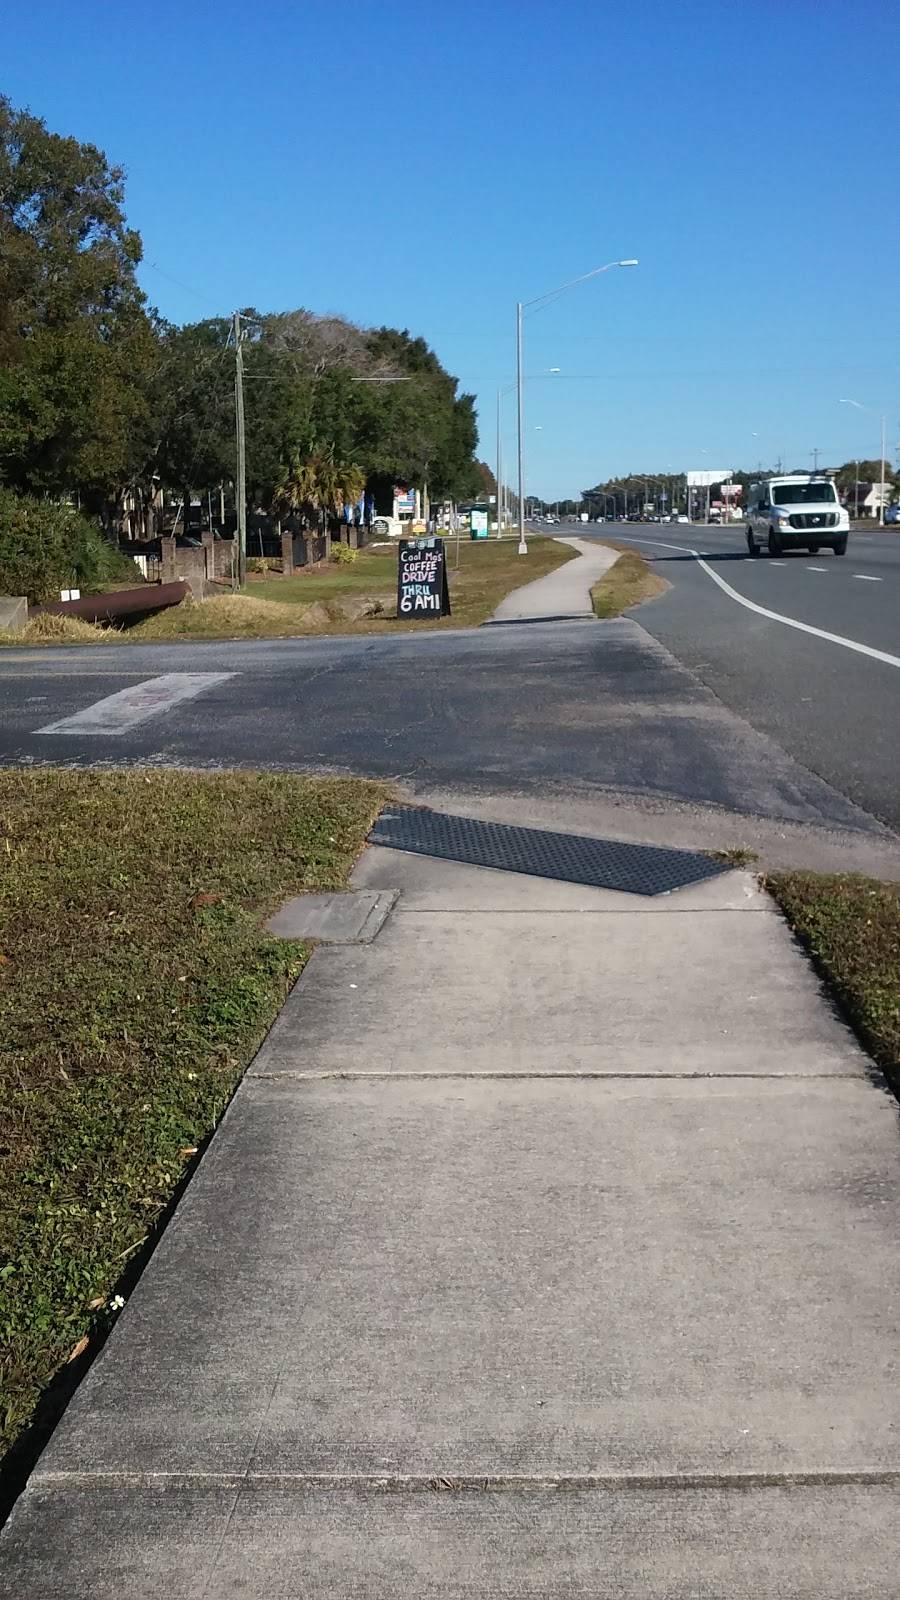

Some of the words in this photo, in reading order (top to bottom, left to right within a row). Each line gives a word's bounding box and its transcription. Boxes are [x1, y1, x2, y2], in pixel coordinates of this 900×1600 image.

[400, 551, 421, 562] Cool
[404, 561, 437, 572] COFFEE
[402, 571, 435, 583] DRIVE
[402, 584, 430, 596] THRU
